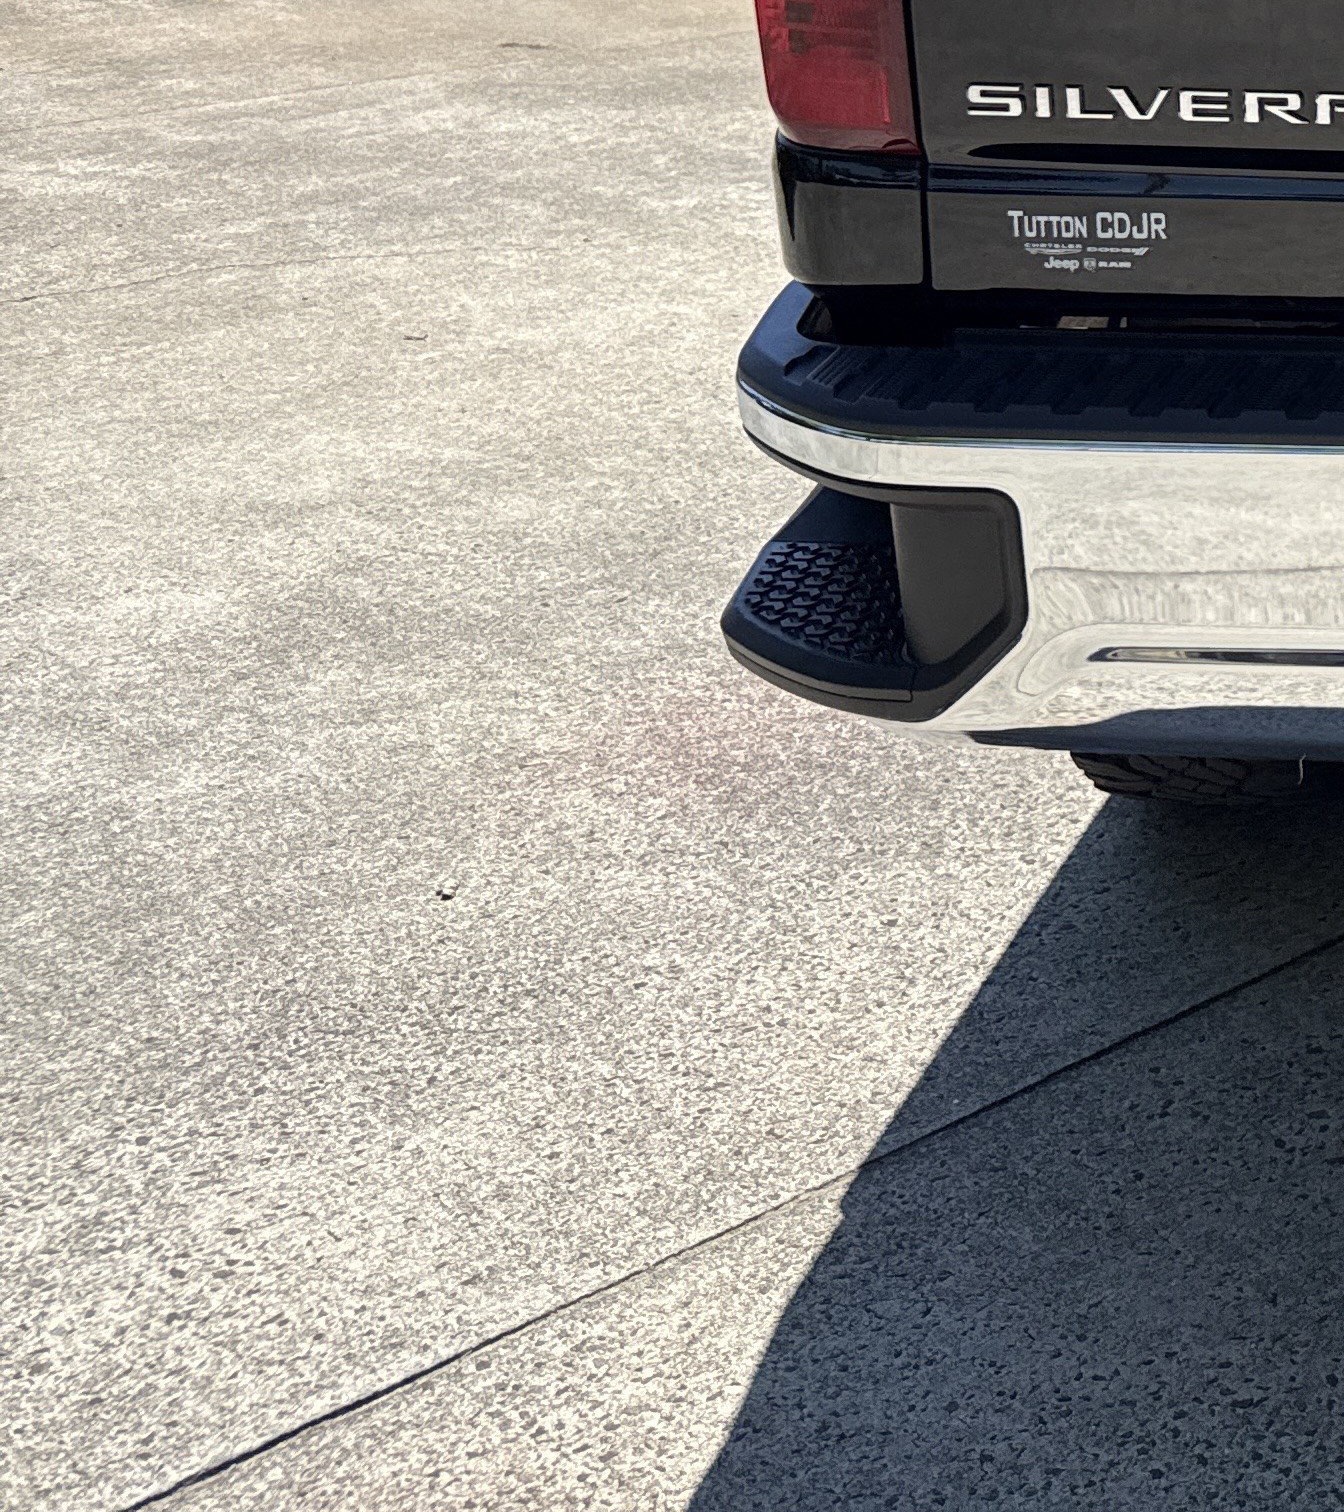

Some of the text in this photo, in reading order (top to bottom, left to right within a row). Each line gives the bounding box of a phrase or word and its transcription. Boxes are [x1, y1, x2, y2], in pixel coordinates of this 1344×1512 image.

[1007, 210, 1168, 239] TUTTON CDJR
[1044, 256, 1132, 273] Jeep RAM
